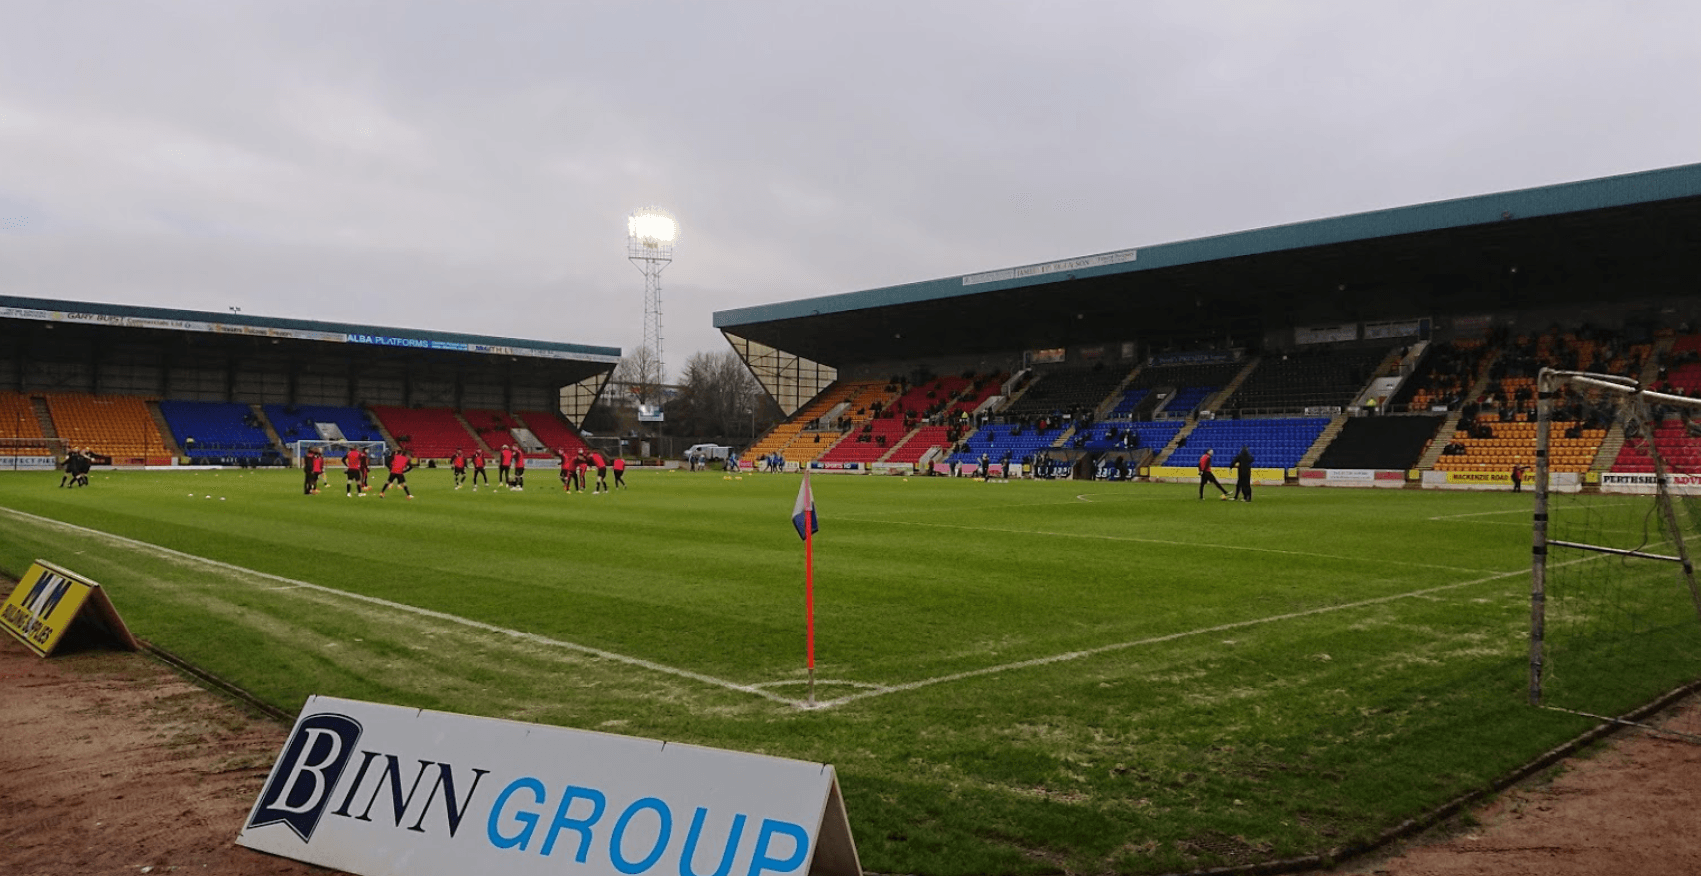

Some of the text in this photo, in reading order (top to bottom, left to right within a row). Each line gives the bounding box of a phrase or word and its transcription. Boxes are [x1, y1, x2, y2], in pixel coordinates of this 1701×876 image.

[67, 312, 93, 320] GARY
[347, 334, 373, 343] ALBA
[375, 336, 429, 348] PLATFORMS
[1603, 475, 1671, 484] PERTHSHI
[266, 727, 810, 876] BINN GROUP
